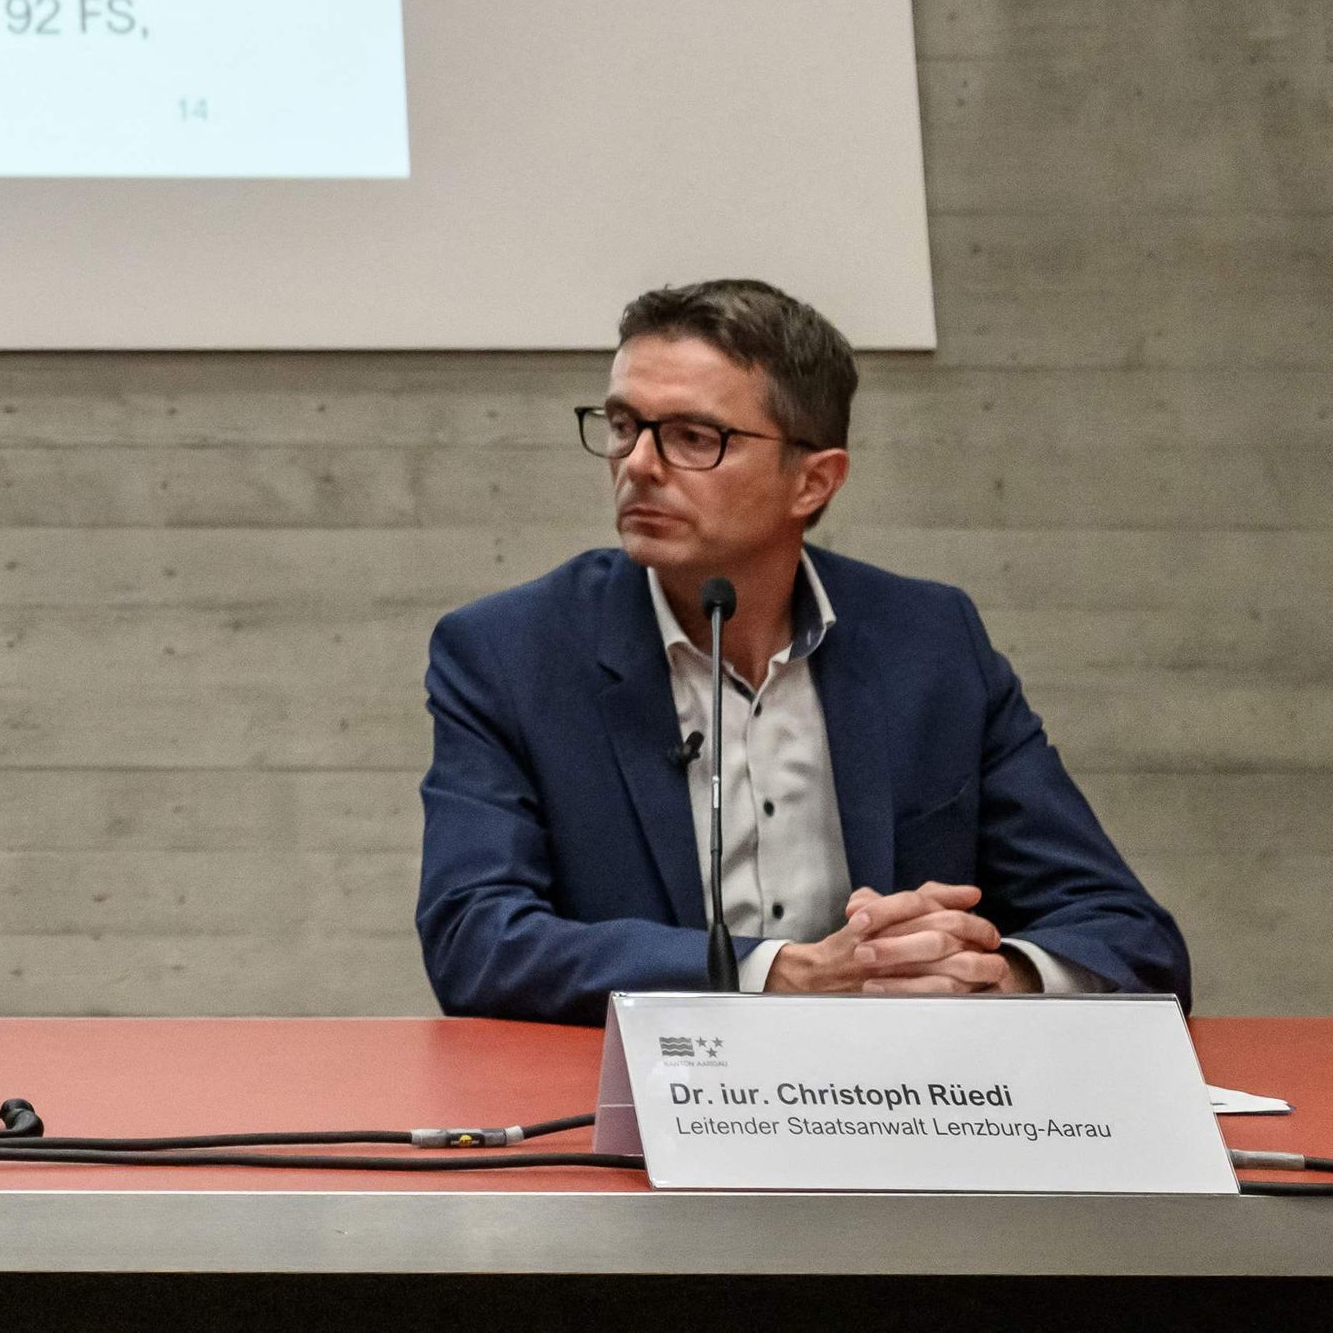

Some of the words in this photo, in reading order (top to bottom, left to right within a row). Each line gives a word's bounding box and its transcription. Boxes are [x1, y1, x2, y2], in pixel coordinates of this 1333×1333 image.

[178, 97, 209, 122] 14
[670, 1082, 713, 1105] Dr.
[721, 1083, 769, 1105] iur.
[777, 1083, 921, 1111] Christoph
[928, 1084, 1013, 1107] Rüedi
[676, 1117, 780, 1135] Leitender
[788, 1117, 928, 1136] Staatsanwalt
[933, 1118, 1112, 1141] Lenzburg-Aarau
